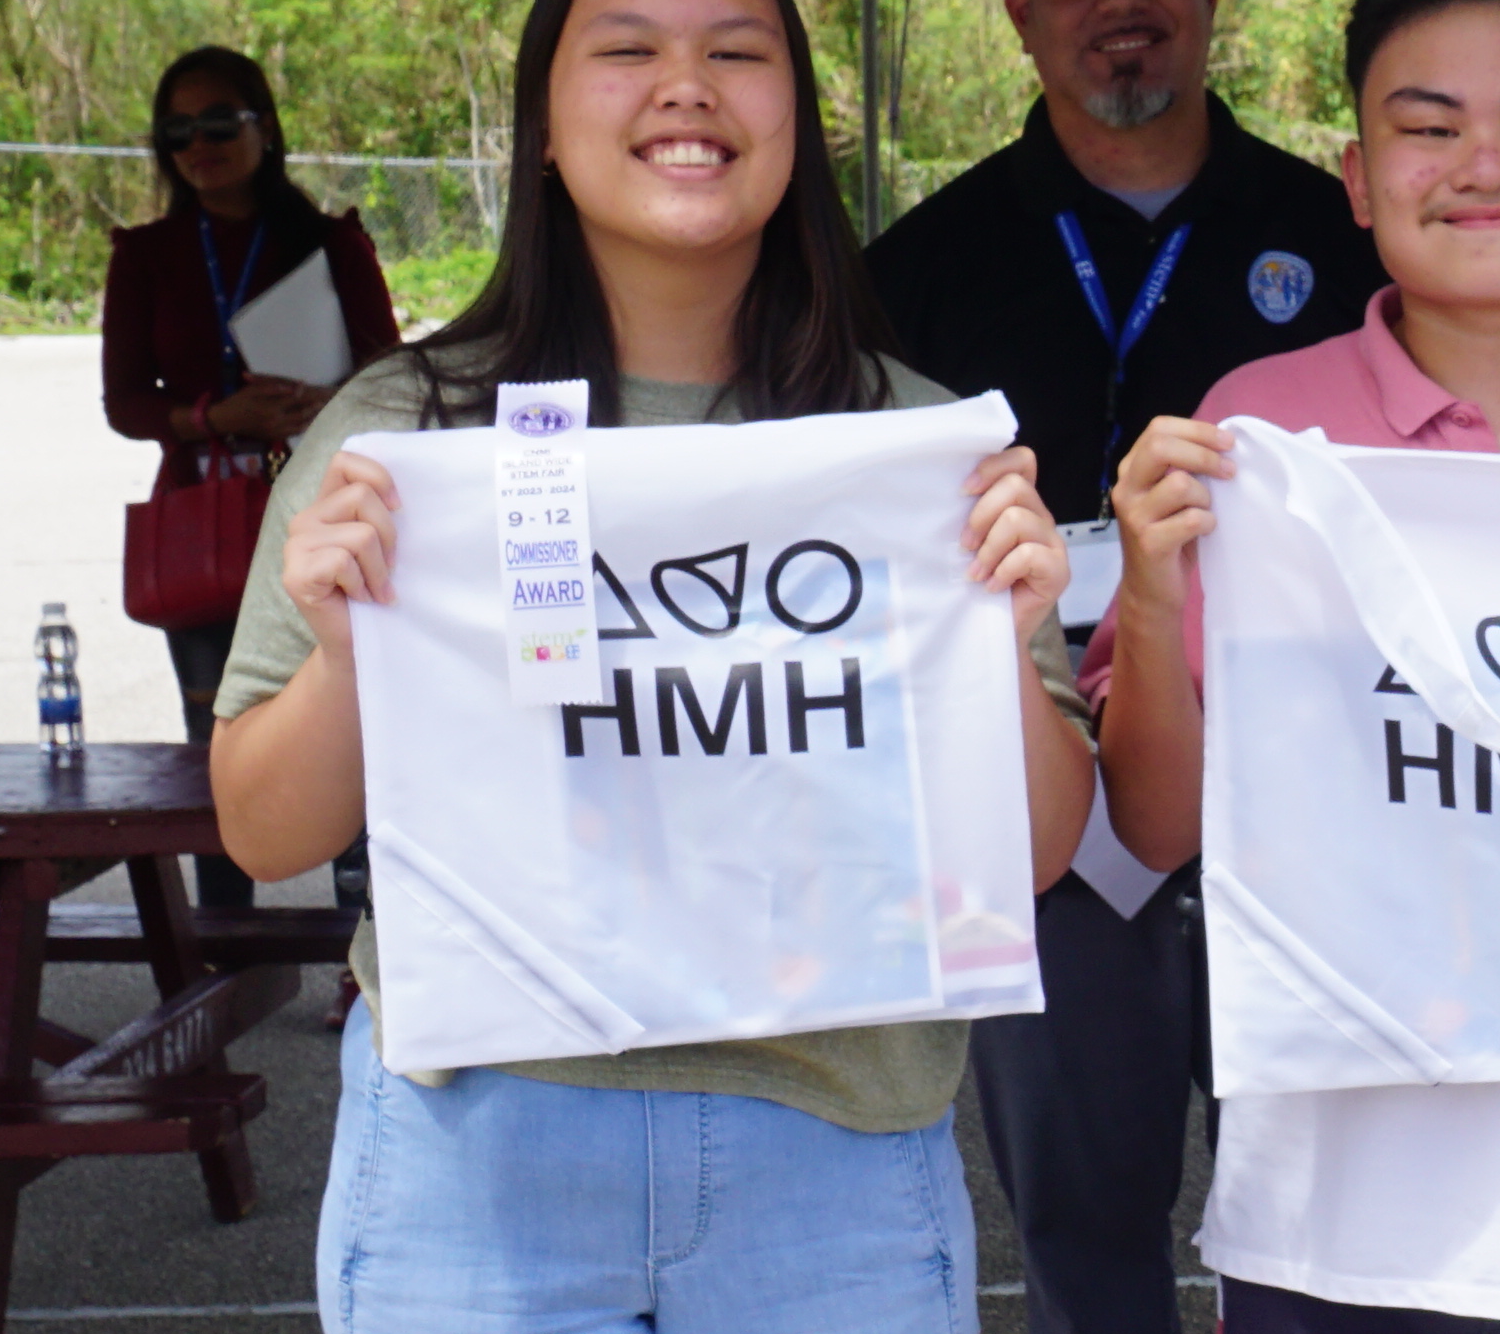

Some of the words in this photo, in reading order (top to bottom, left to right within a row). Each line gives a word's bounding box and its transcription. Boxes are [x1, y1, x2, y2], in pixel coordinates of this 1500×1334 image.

[508, 511, 523, 527] 9
[545, 508, 571, 525] 12
[513, 578, 584, 605] AWARD
[561, 657, 865, 757] HMH
